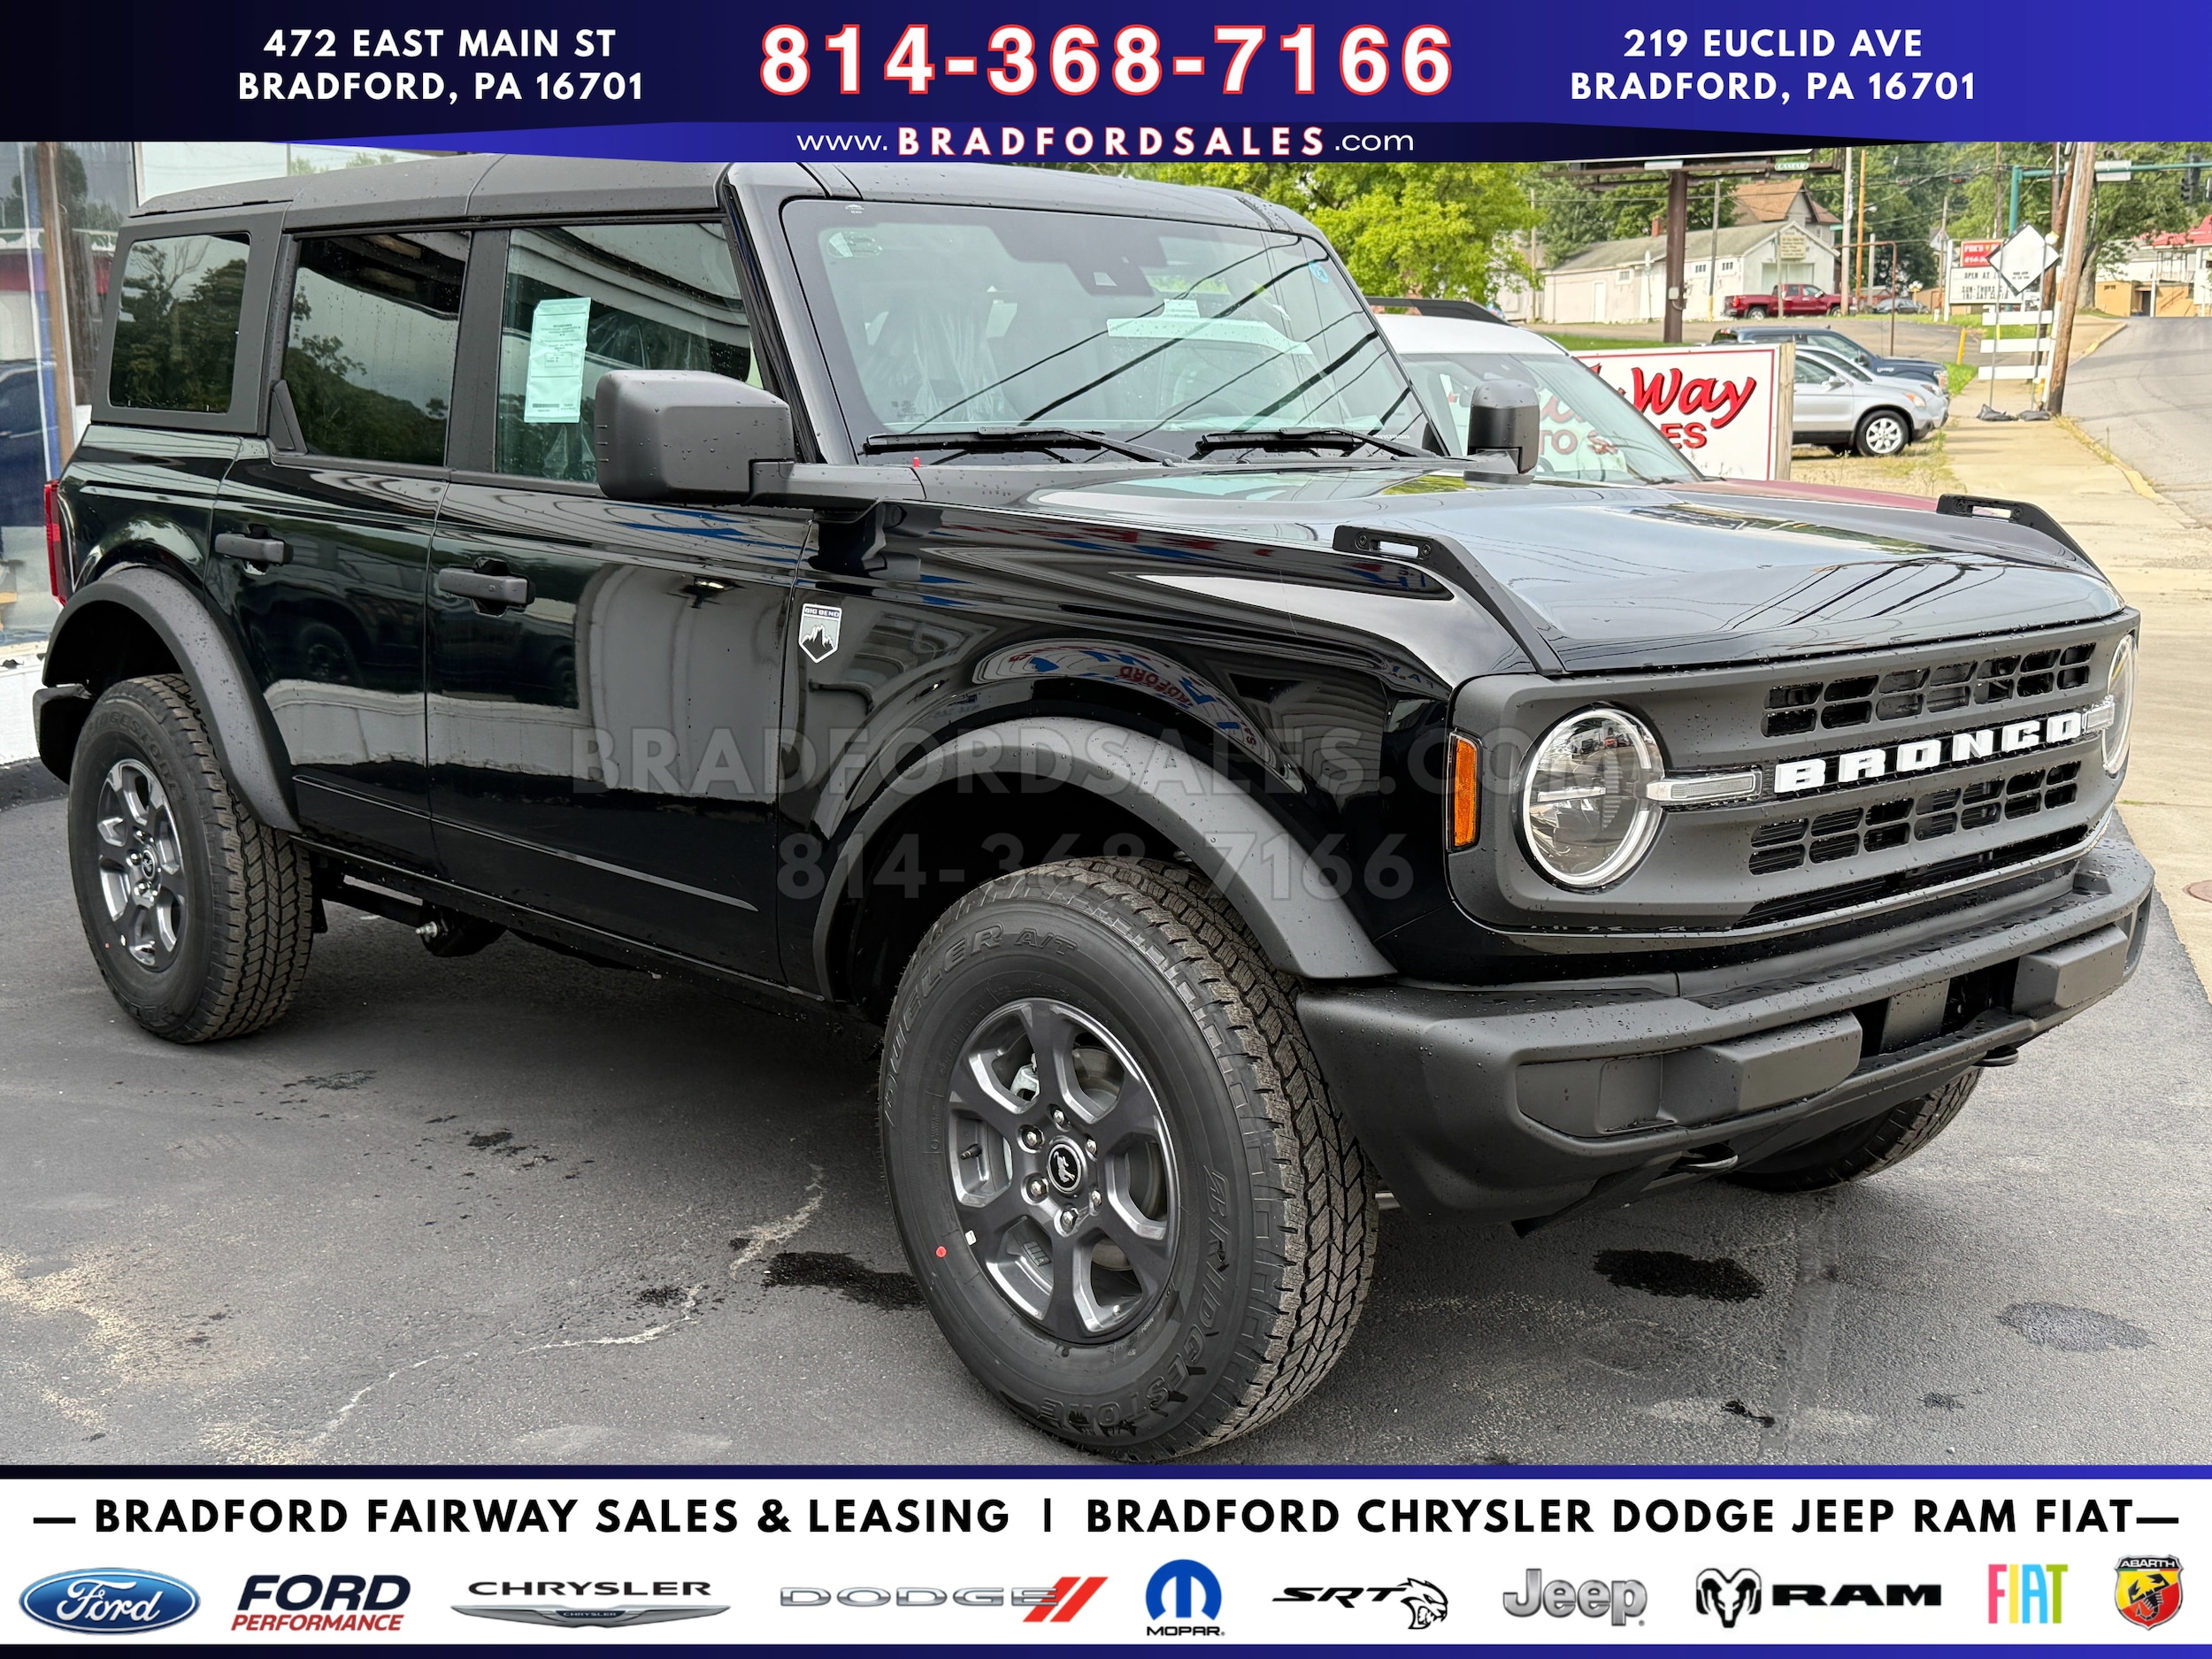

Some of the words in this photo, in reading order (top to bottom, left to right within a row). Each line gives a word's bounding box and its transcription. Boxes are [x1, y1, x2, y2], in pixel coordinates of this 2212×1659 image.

[1631, 366, 1757, 429] Way
[818, 609, 840, 618] BEND
[1773, 711, 2082, 794] BRONCO
